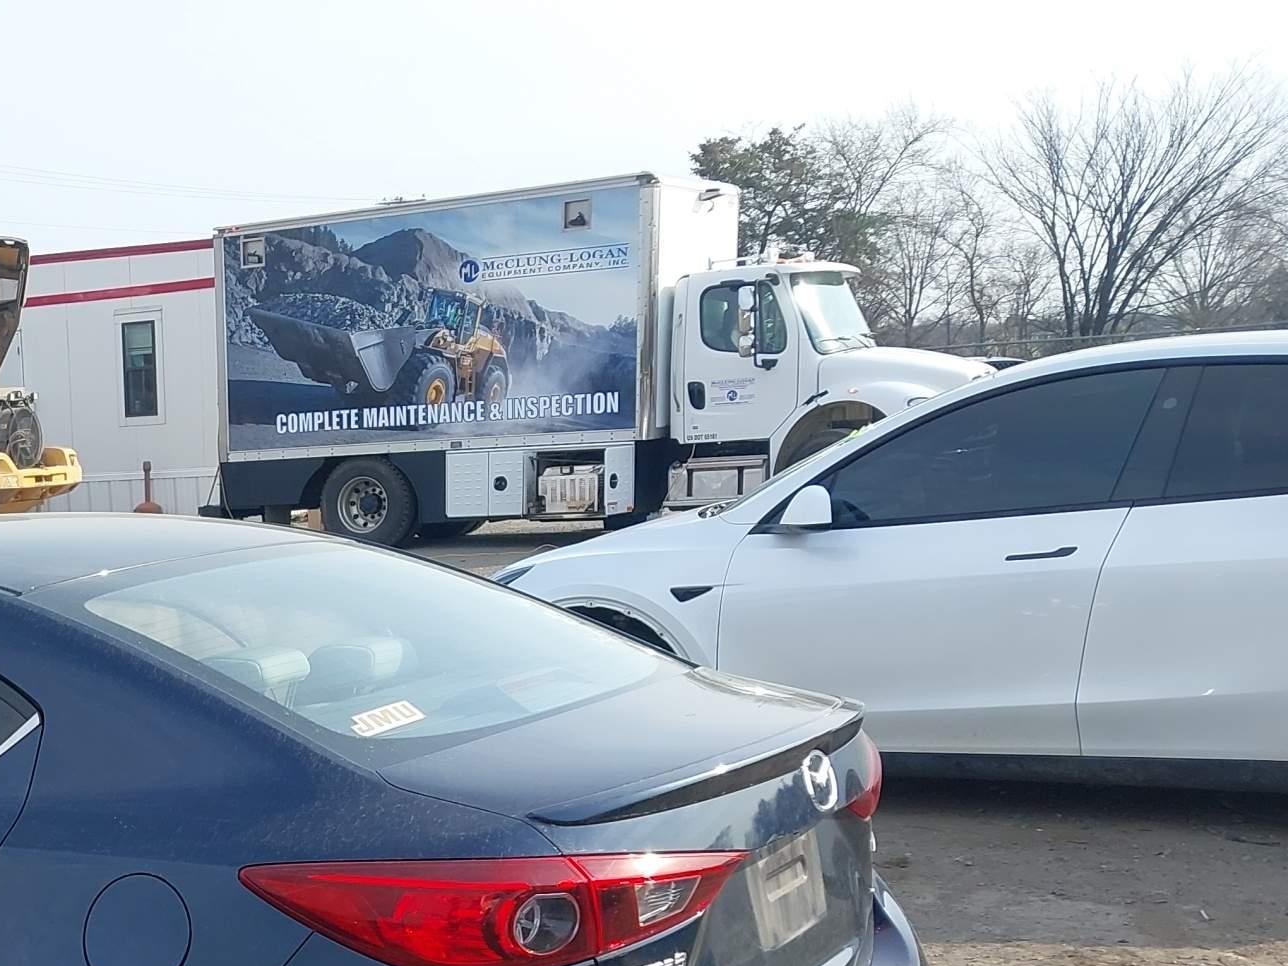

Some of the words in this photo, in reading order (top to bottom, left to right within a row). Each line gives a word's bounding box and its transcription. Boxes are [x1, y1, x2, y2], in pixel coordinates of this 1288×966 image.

[482, 246, 629, 271] McCLUNG-LOGAN
[481, 266, 542, 280] EQUIPMENT
[276, 408, 359, 433] COMPLETE
[362, 400, 486, 429] MAINTENANCE
[490, 402, 503, 421] &
[507, 391, 619, 420] INSPECTION
